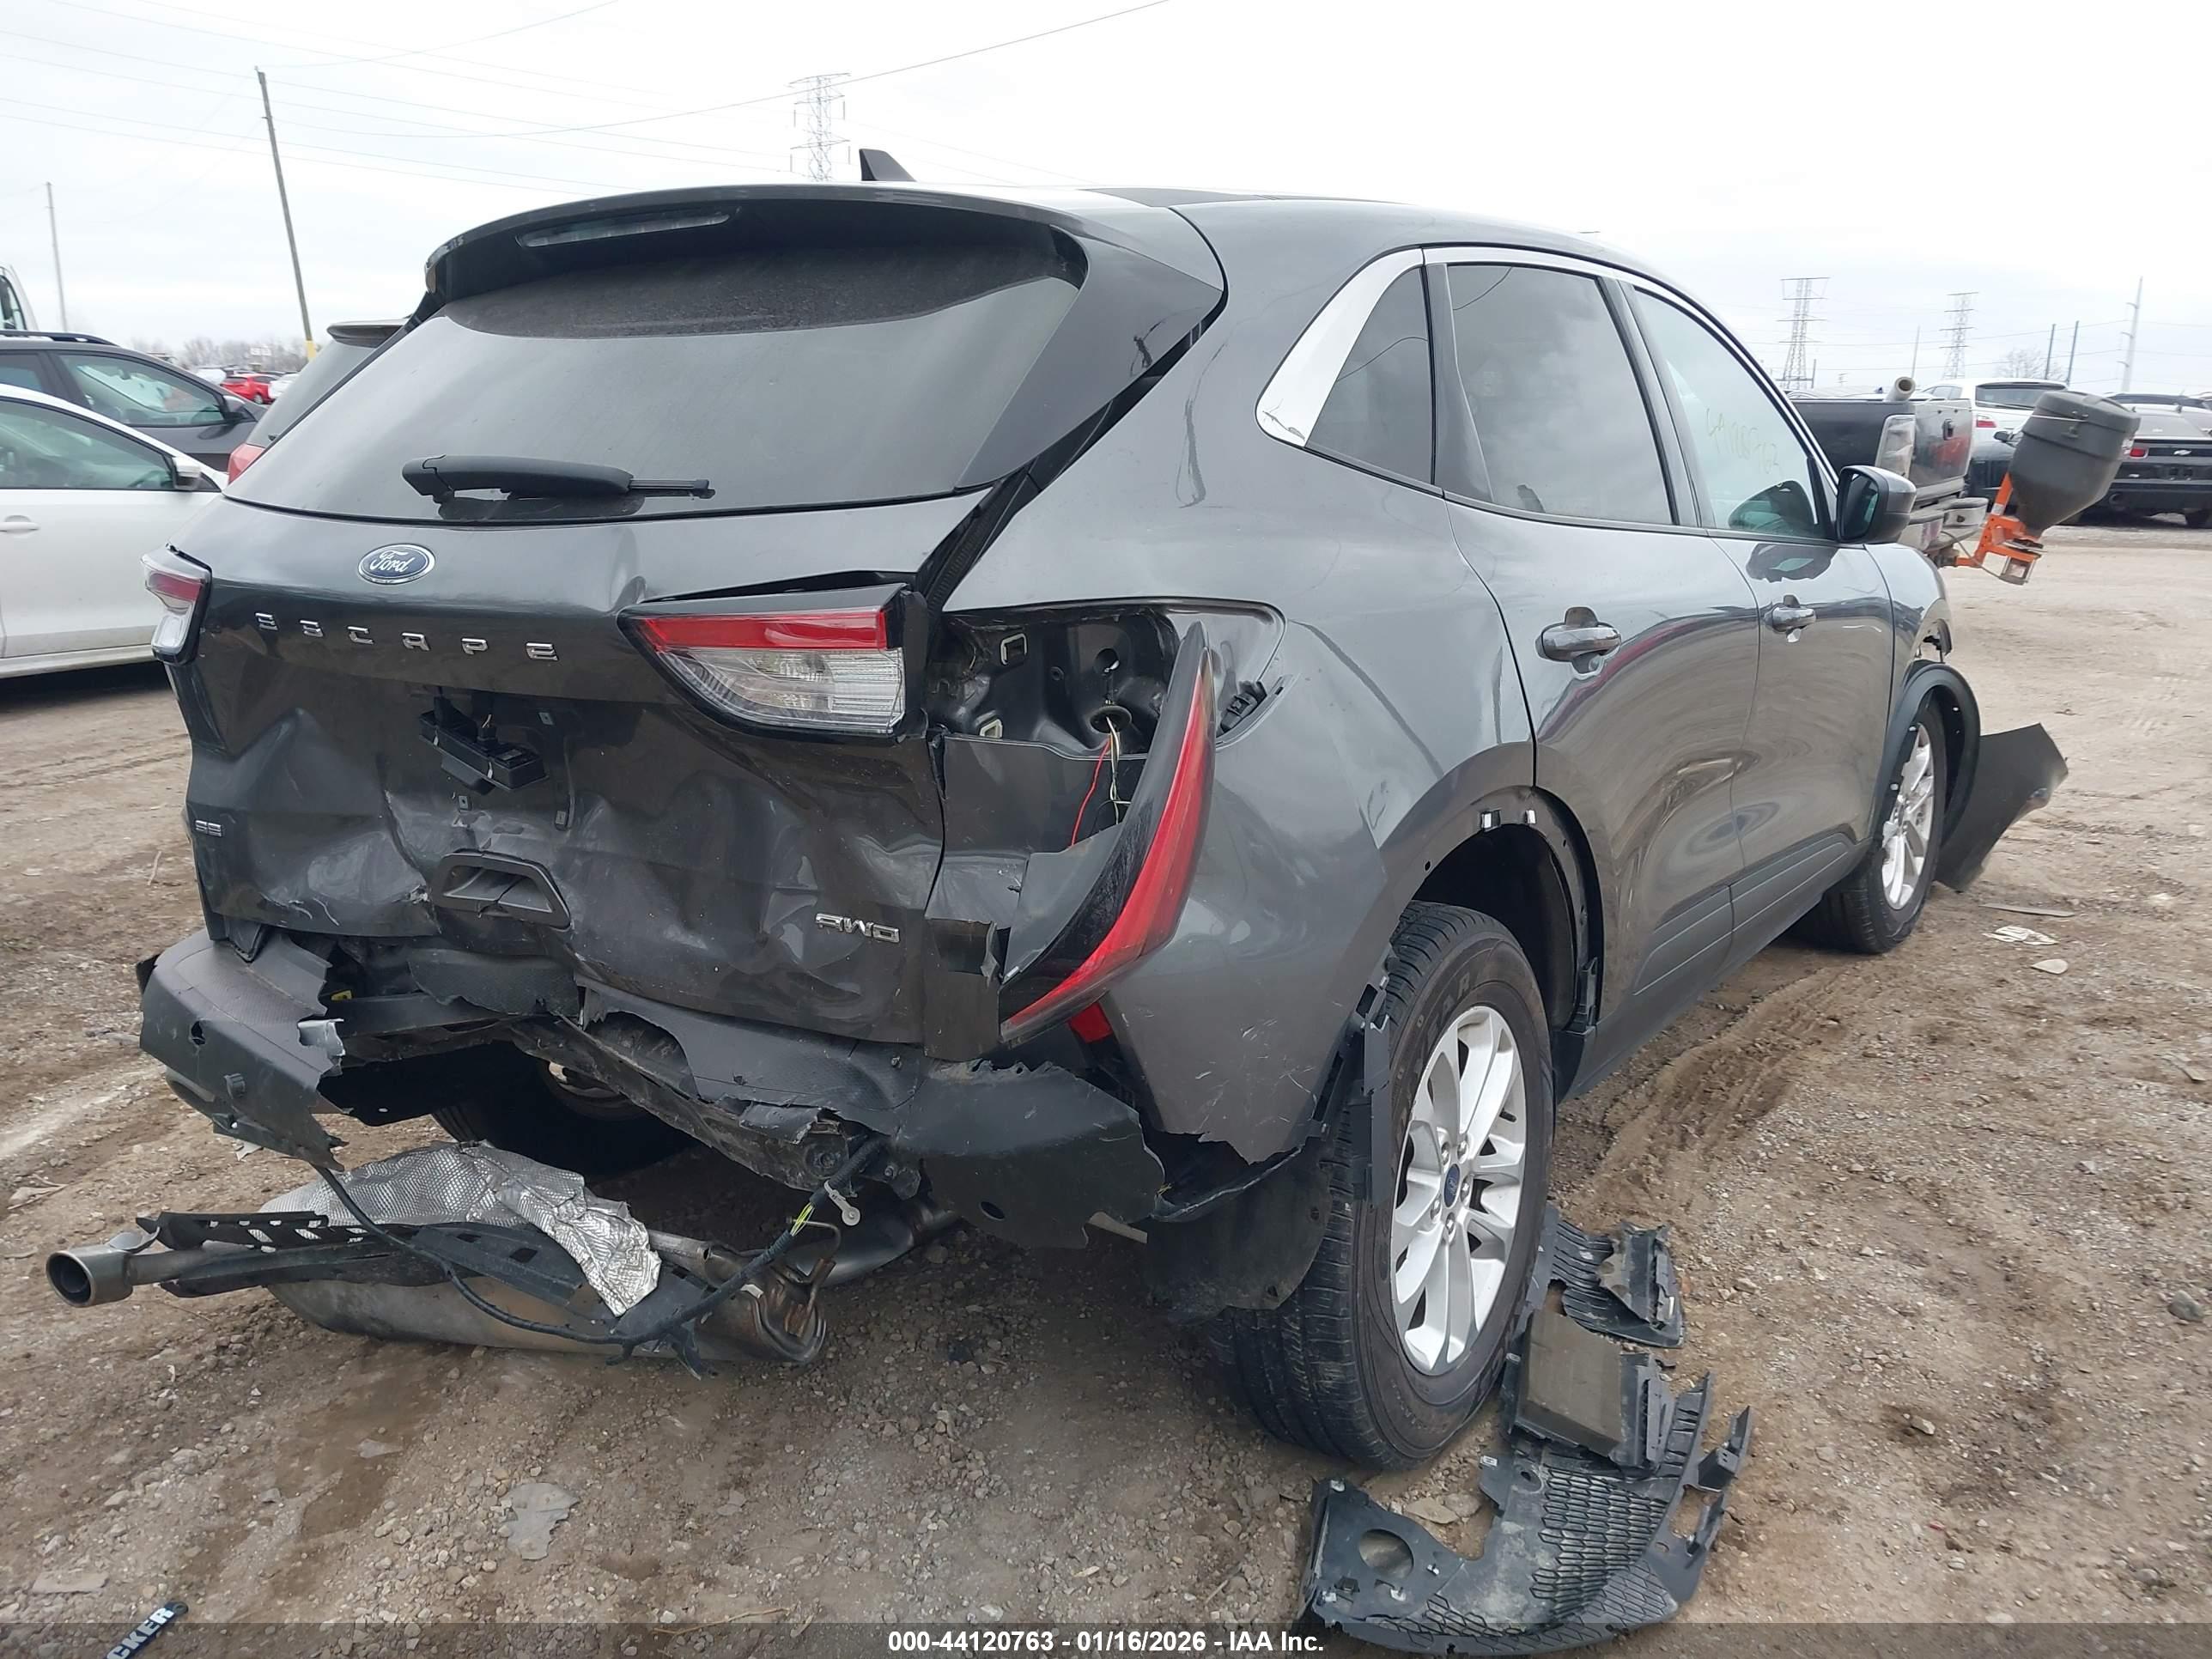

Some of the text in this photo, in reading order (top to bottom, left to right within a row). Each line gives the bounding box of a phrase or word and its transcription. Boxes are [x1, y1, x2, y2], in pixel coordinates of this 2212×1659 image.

[370, 550, 416, 573] Ford
[255, 612, 559, 662] ESCAPE
[195, 819, 222, 837] SE
[816, 913, 900, 943] AWD
